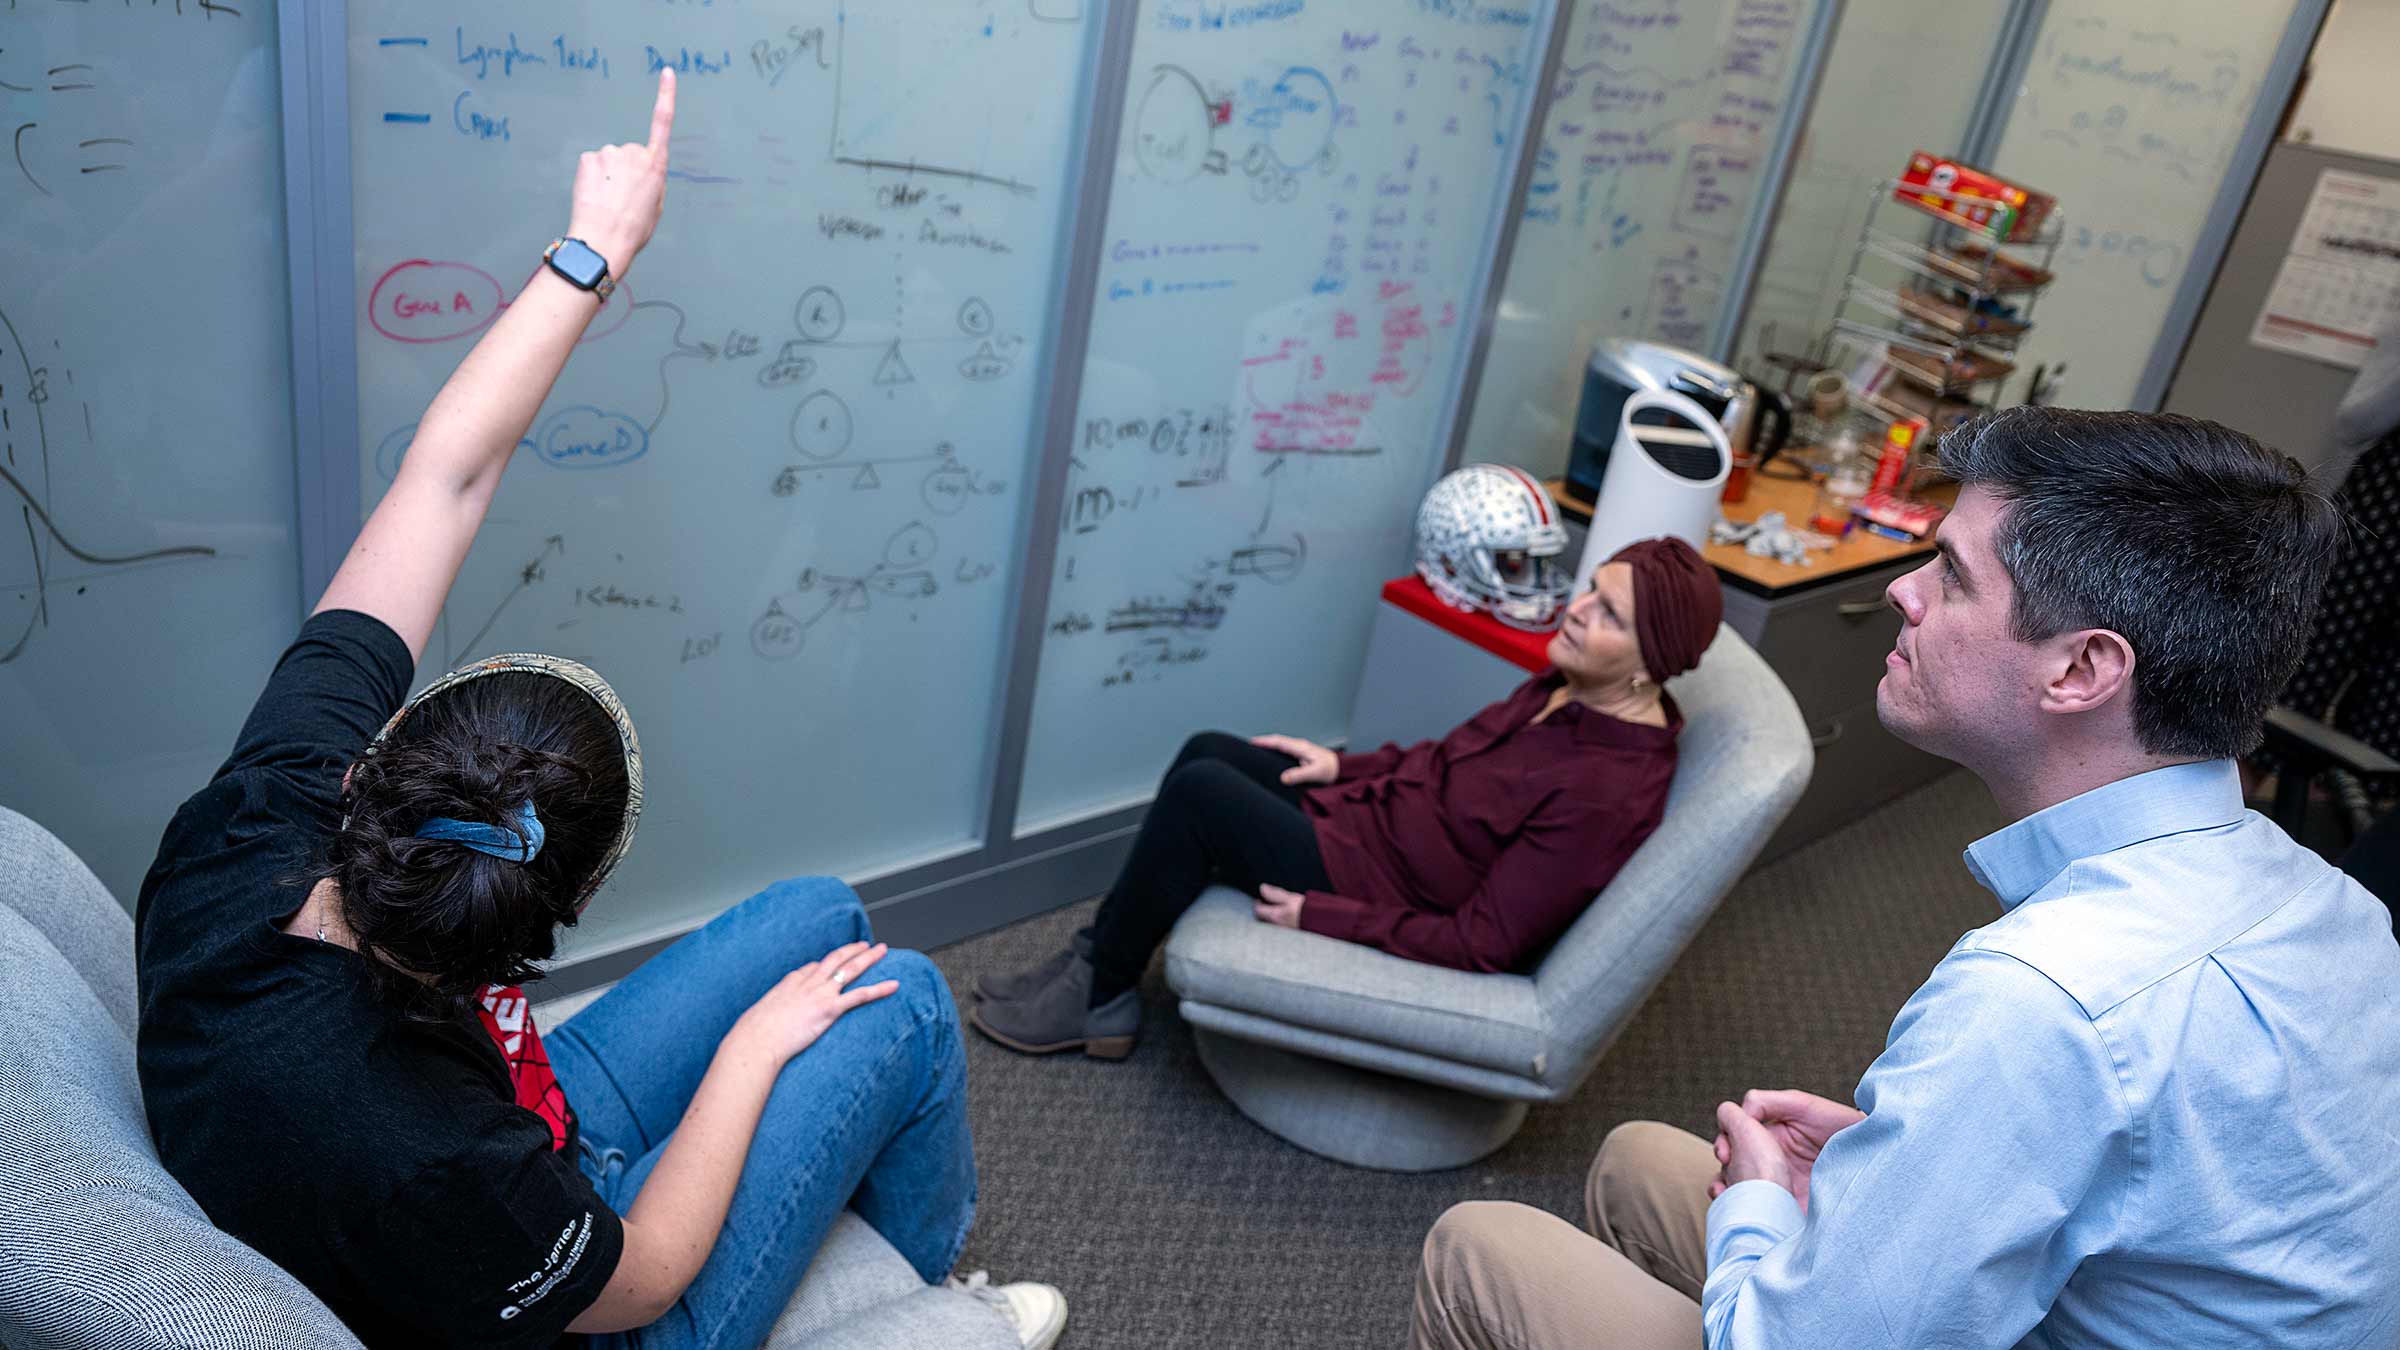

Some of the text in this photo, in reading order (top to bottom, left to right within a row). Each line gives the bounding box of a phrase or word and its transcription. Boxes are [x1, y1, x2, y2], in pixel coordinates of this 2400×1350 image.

[393, 291, 474, 319] Gene A
[507, 1219, 577, 1293] The James
